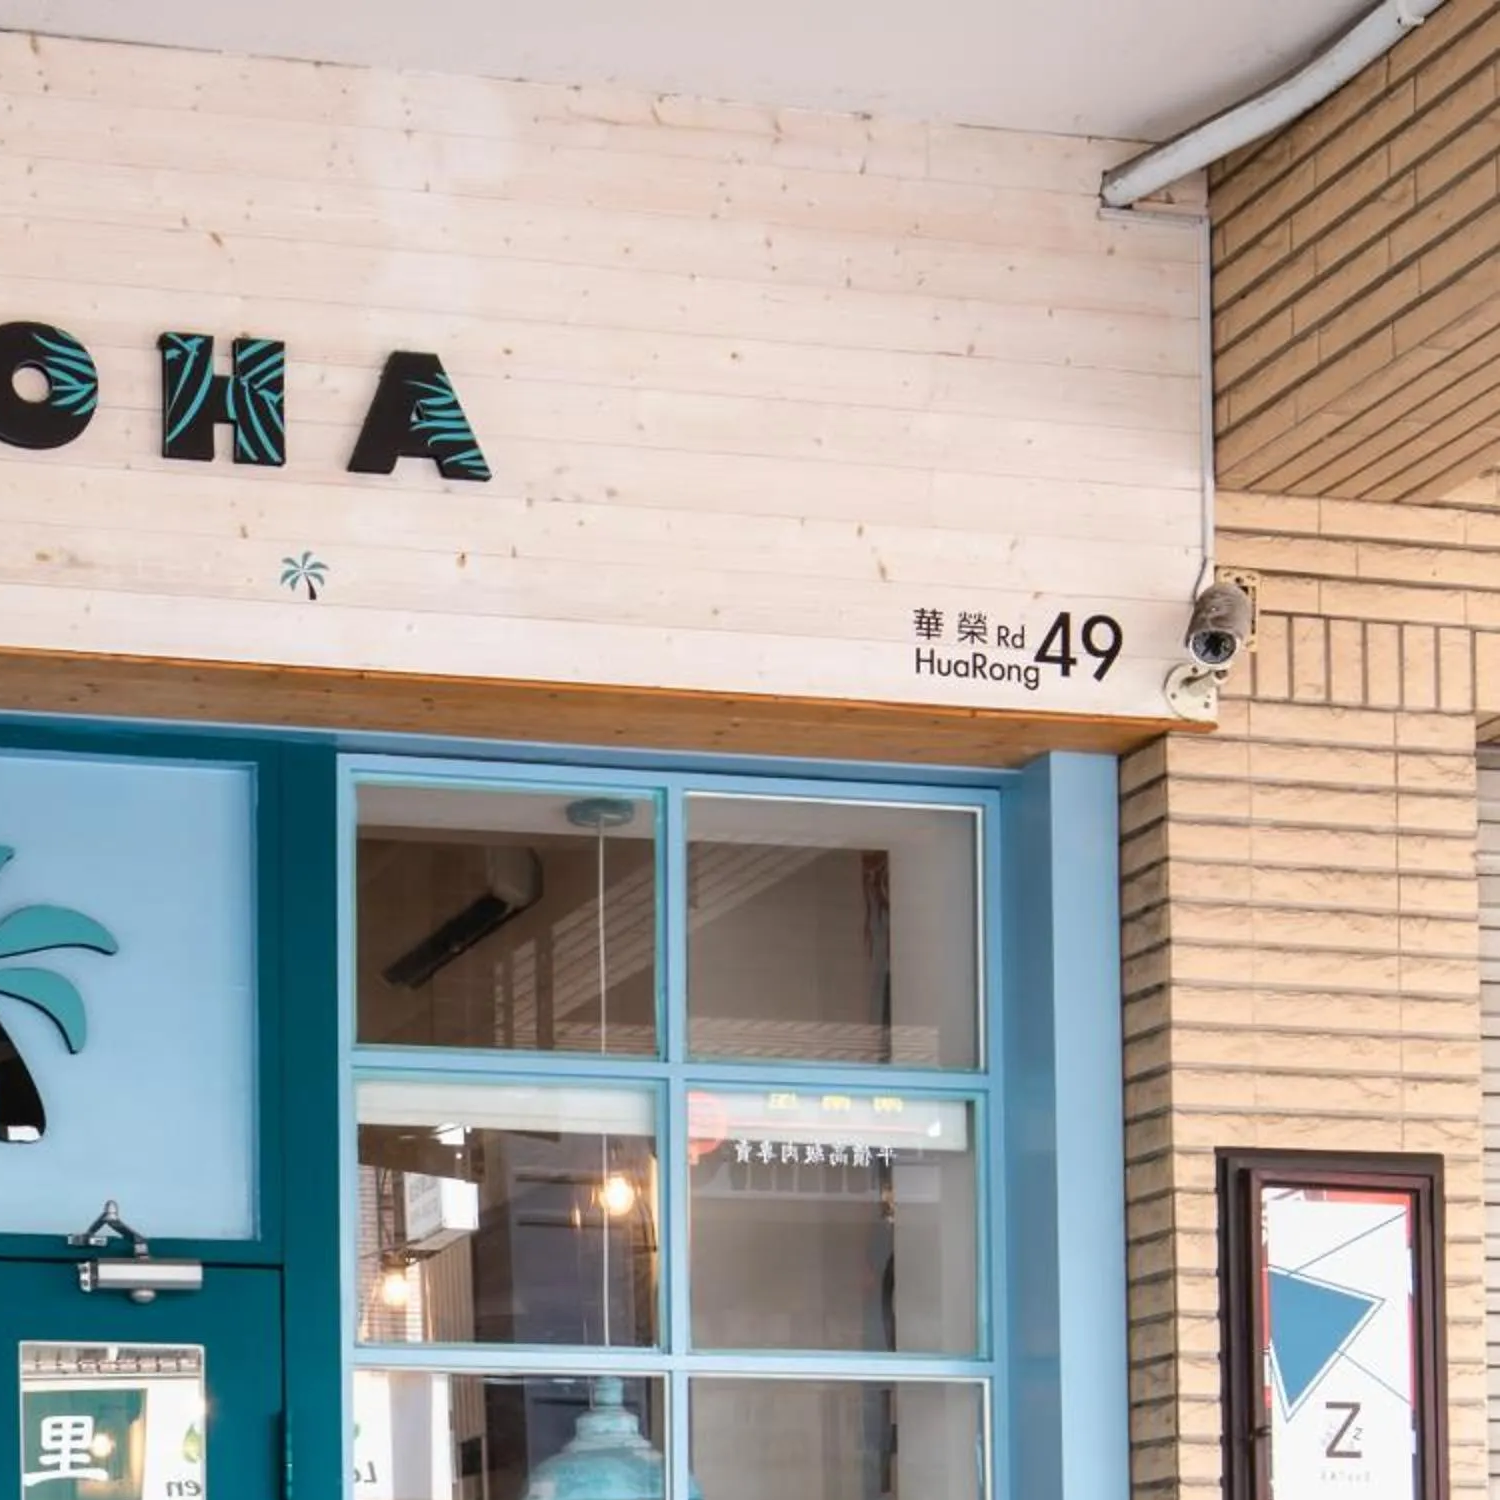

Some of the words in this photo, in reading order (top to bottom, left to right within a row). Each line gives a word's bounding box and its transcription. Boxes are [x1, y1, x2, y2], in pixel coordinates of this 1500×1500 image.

[913, 607, 989, 645] 華榮
[997, 624, 1026, 649] Rd
[1033, 611, 1124, 682] 49
[915, 647, 1040, 691] HuaRong
